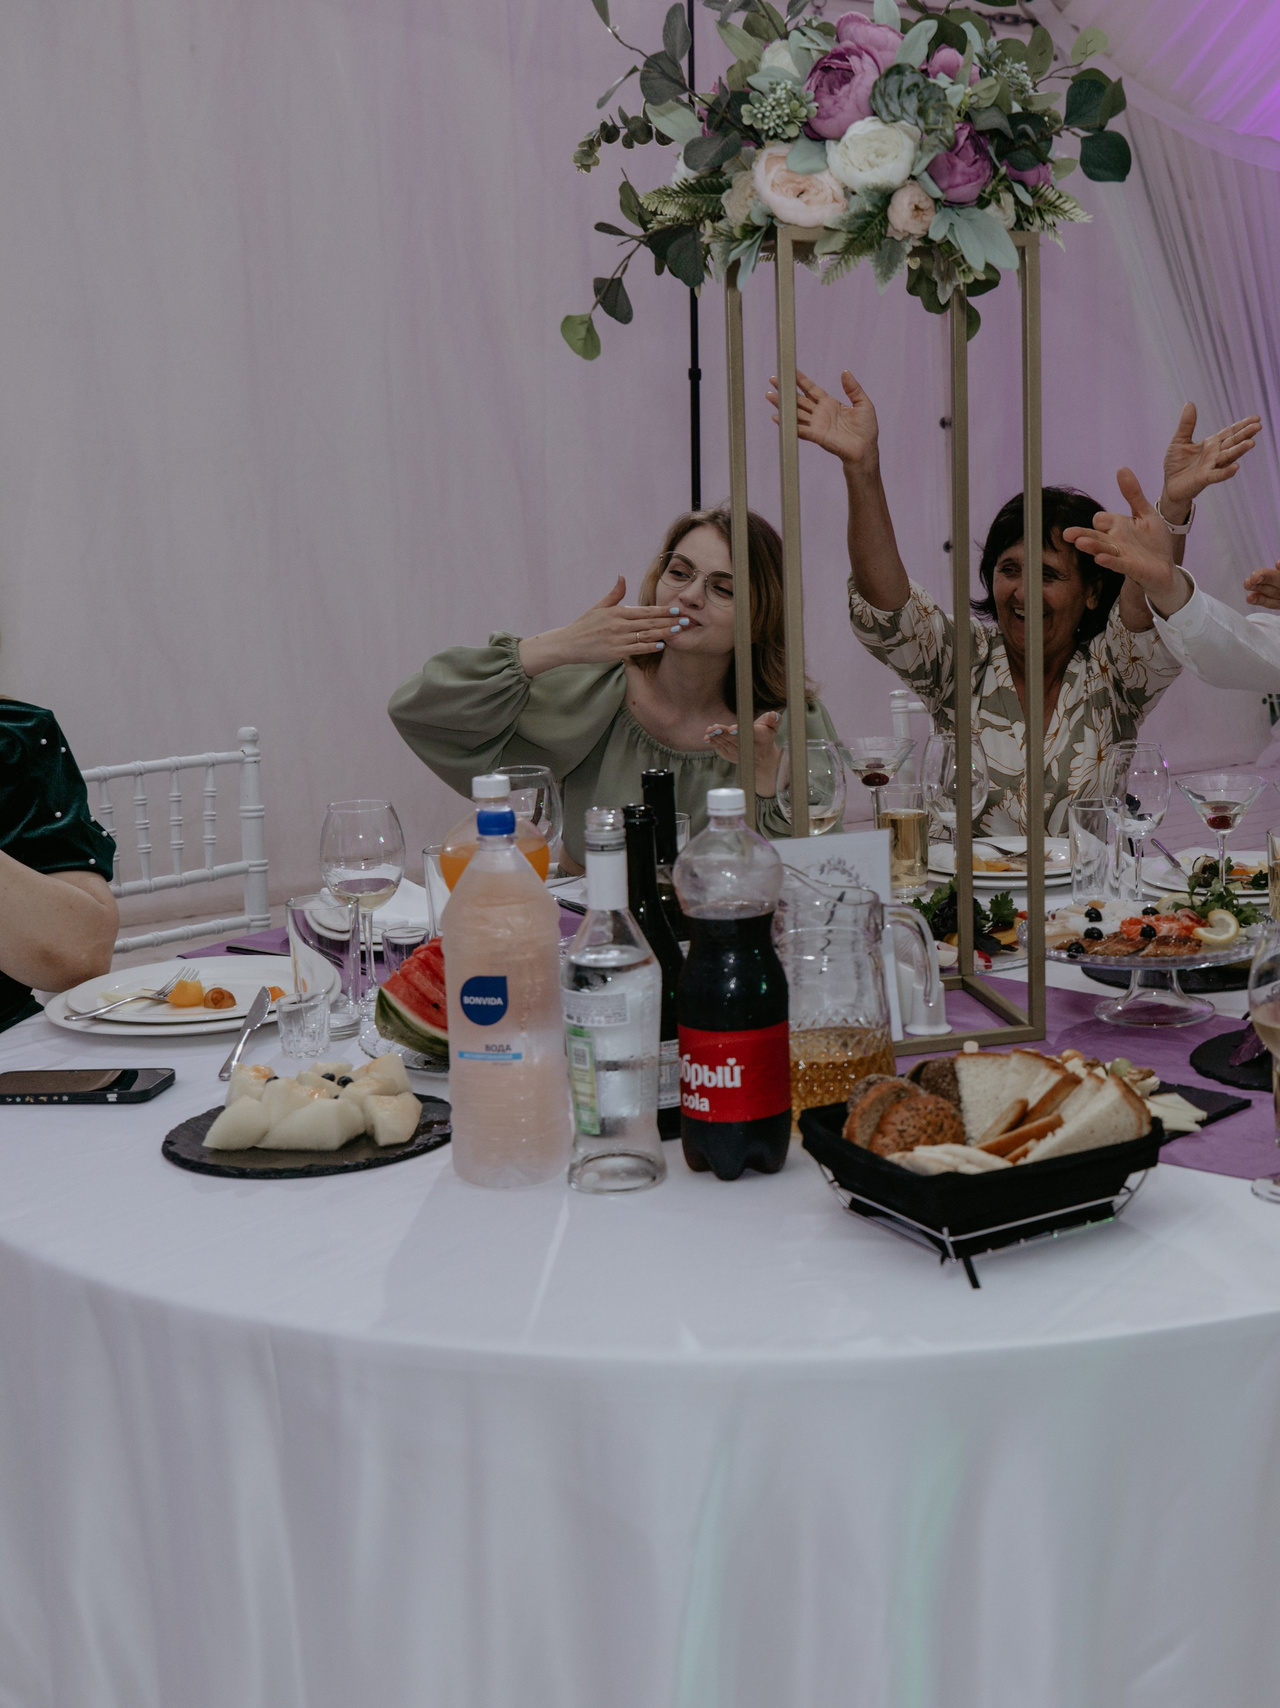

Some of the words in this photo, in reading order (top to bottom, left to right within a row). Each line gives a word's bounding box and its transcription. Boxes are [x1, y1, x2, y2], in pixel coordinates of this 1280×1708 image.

[462, 995, 504, 1006] BONVIDA
[485, 1044, 512, 1053] ВОДА
[682, 1092, 710, 1112] cola
